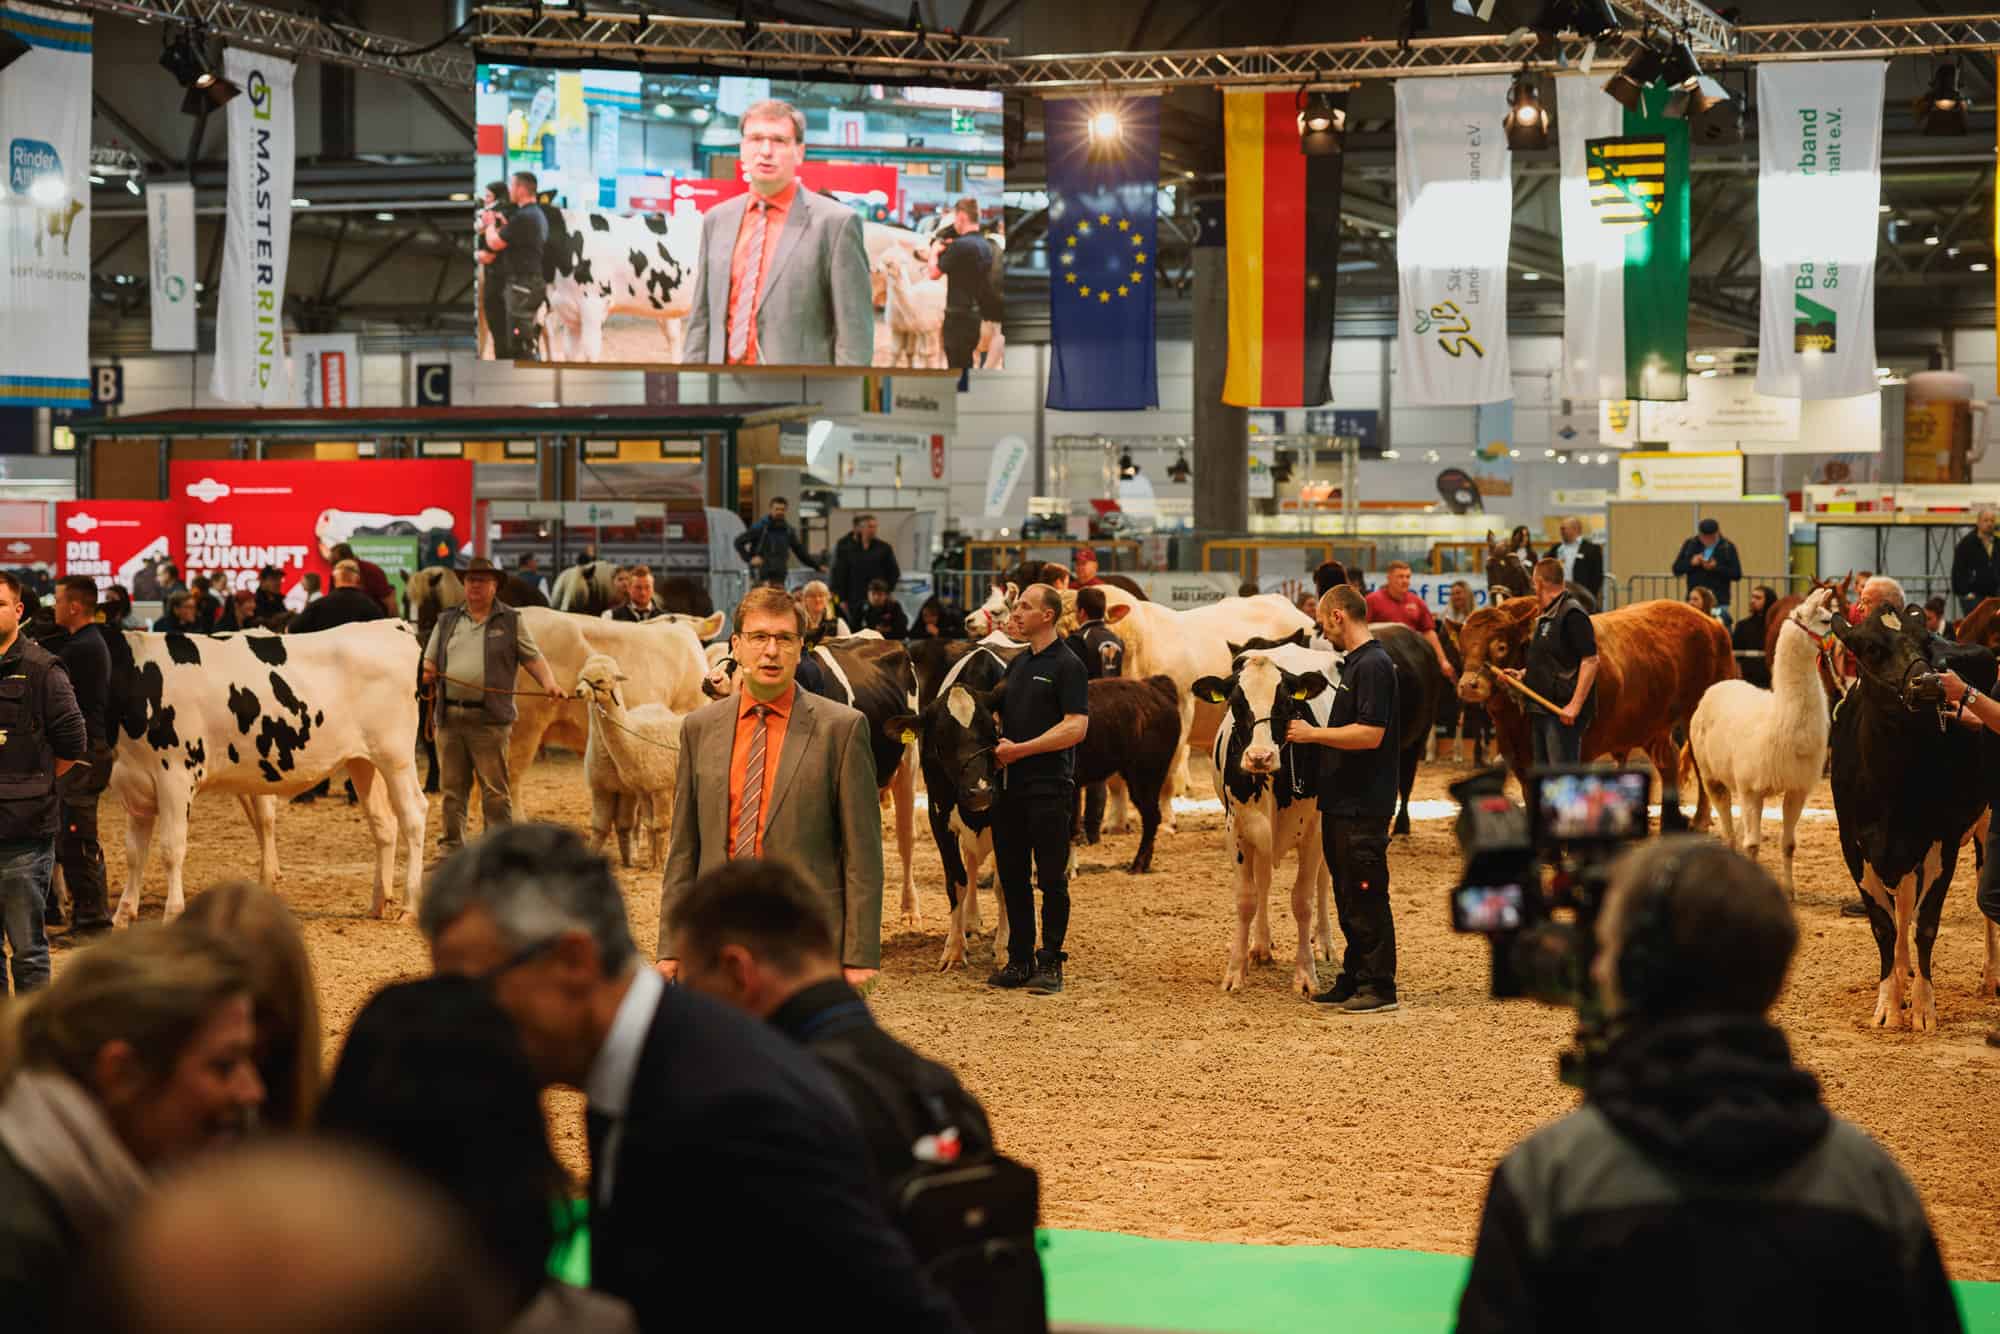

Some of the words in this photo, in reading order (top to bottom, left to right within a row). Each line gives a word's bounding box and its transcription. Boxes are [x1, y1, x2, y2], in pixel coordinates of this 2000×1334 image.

[13, 146, 56, 169] Rinder
[256, 129, 275, 390] MASTERRIND
[98, 367, 116, 401] B
[423, 366, 445, 402] C
[186, 523, 233, 546] DIE
[66, 541, 100, 560] DIE
[186, 546, 309, 569] ZUKUNFT
